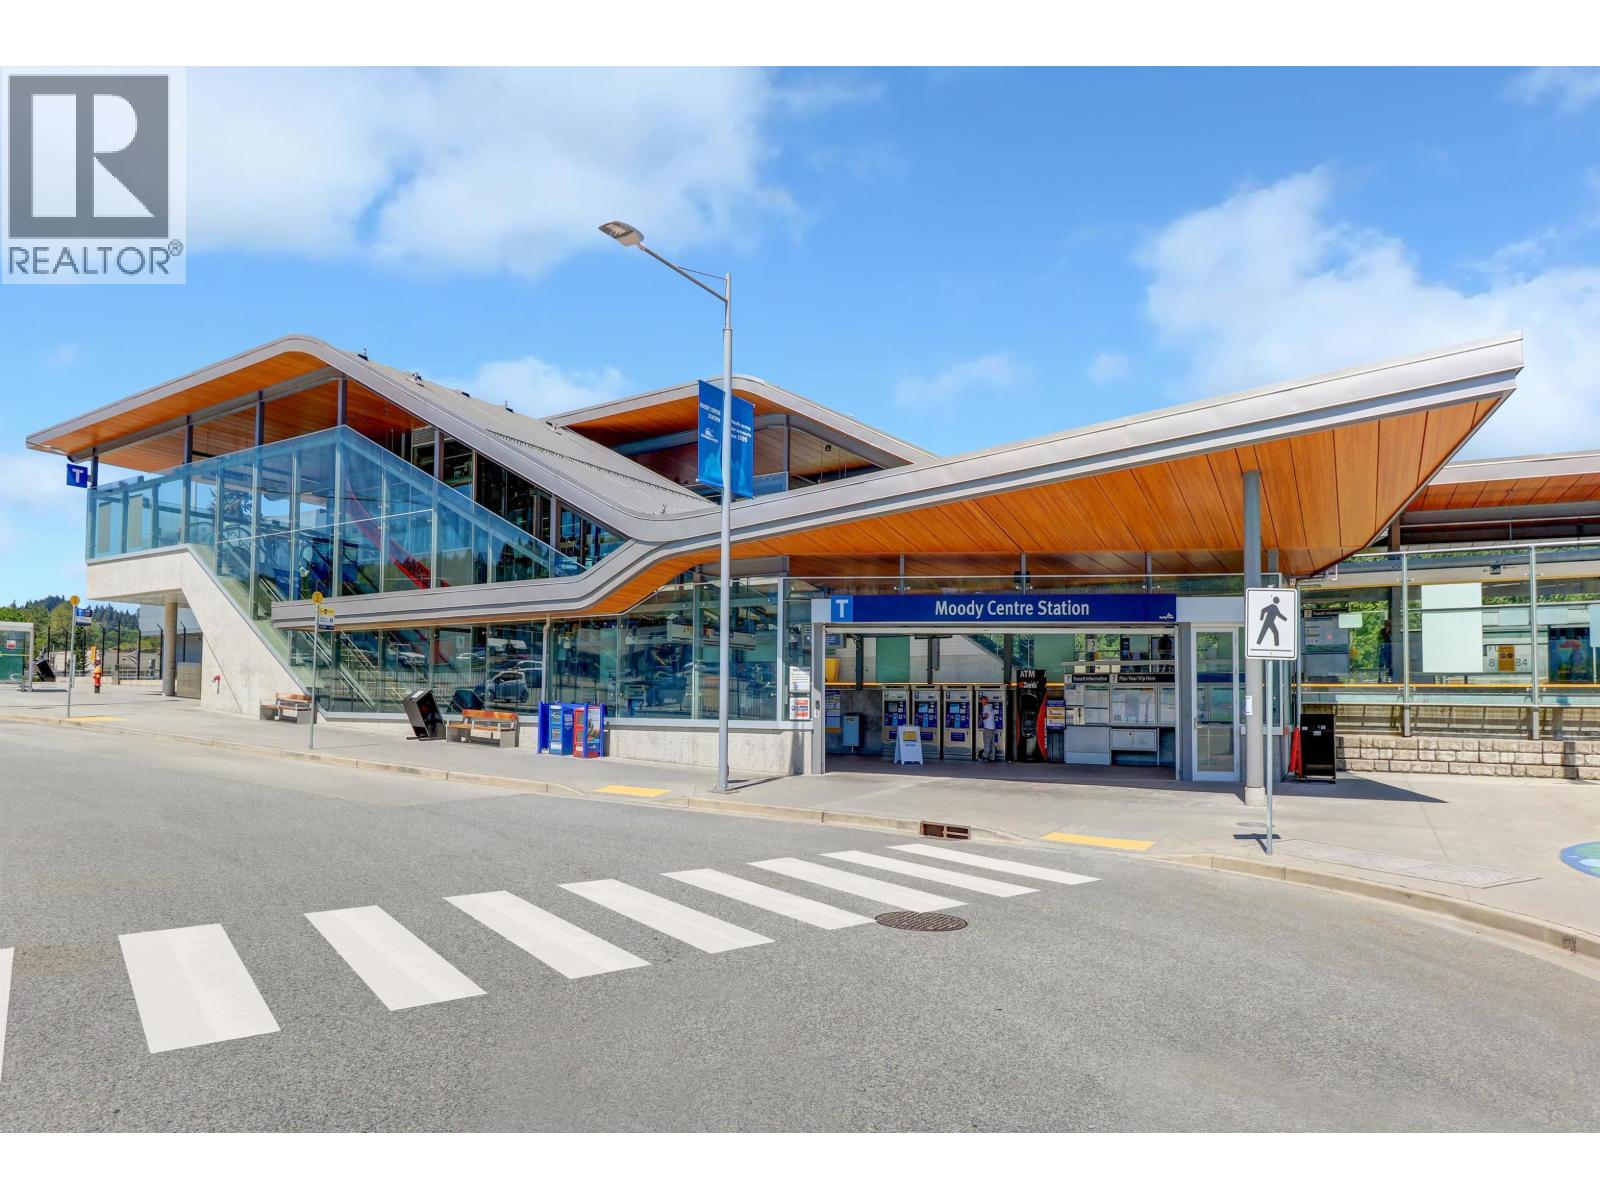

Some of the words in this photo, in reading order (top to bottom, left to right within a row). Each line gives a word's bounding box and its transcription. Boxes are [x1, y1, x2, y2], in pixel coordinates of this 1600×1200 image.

[72, 468, 84, 484] T
[836, 600, 849, 618] T
[935, 600, 983, 619] Moody
[987, 600, 1034, 616] Centre
[1037, 600, 1090, 616] Station
[1020, 670, 1036, 678] ATM
